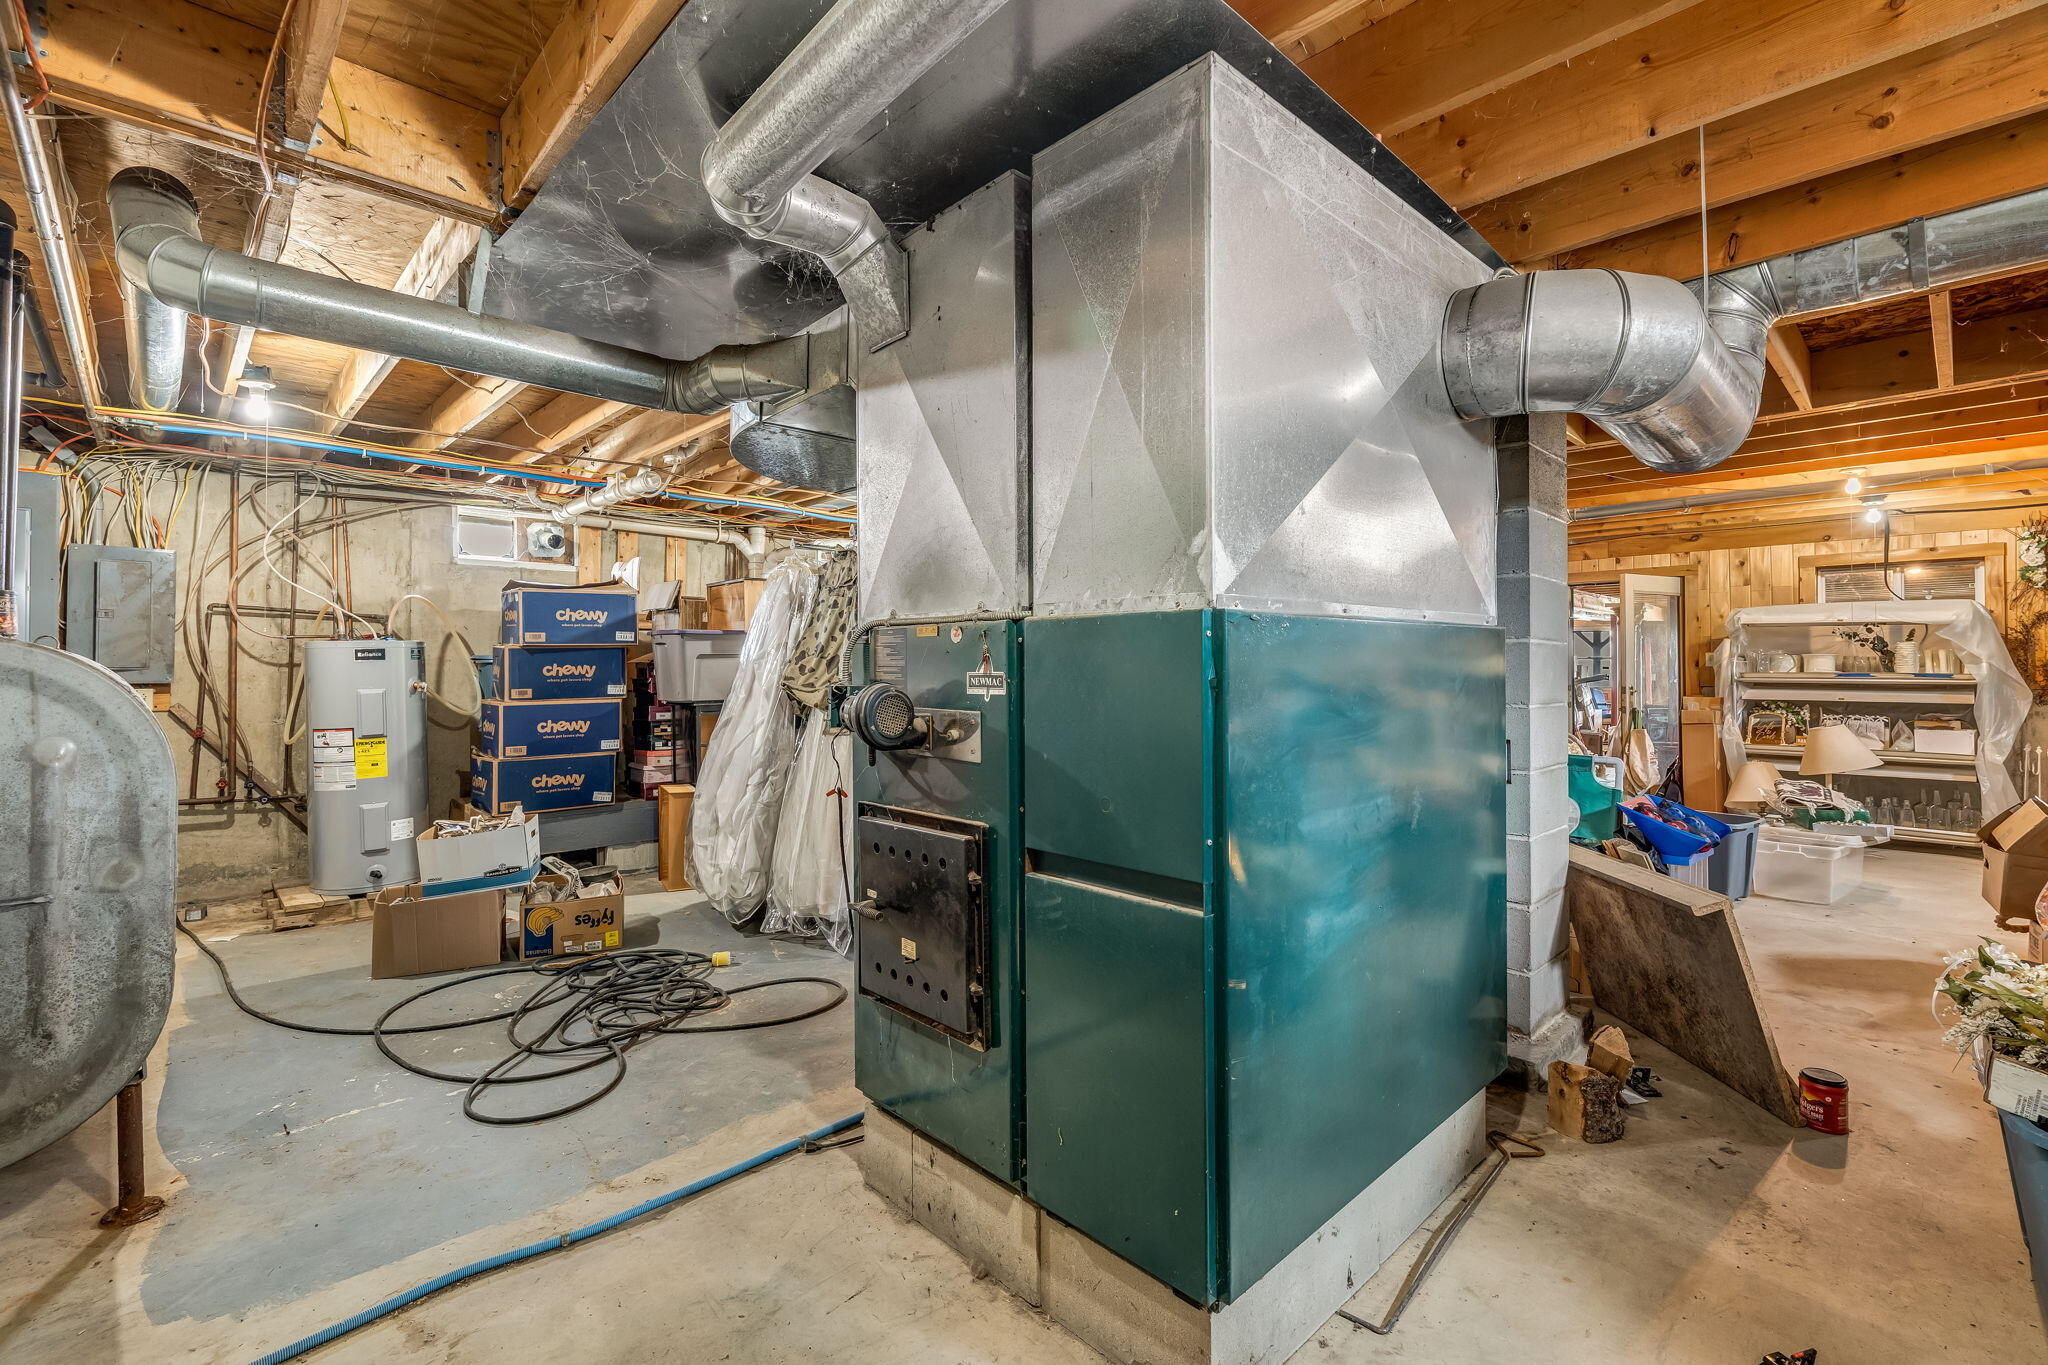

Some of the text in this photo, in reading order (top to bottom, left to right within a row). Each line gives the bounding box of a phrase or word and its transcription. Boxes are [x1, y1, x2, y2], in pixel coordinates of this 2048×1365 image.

[555, 607, 608, 623] chewy
[542, 663, 596, 678] chewy
[970, 677, 1002, 686] NEWMAC
[536, 719, 591, 733] chewy
[531, 773, 585, 788] chewy
[575, 907, 614, 928] Fyffes
